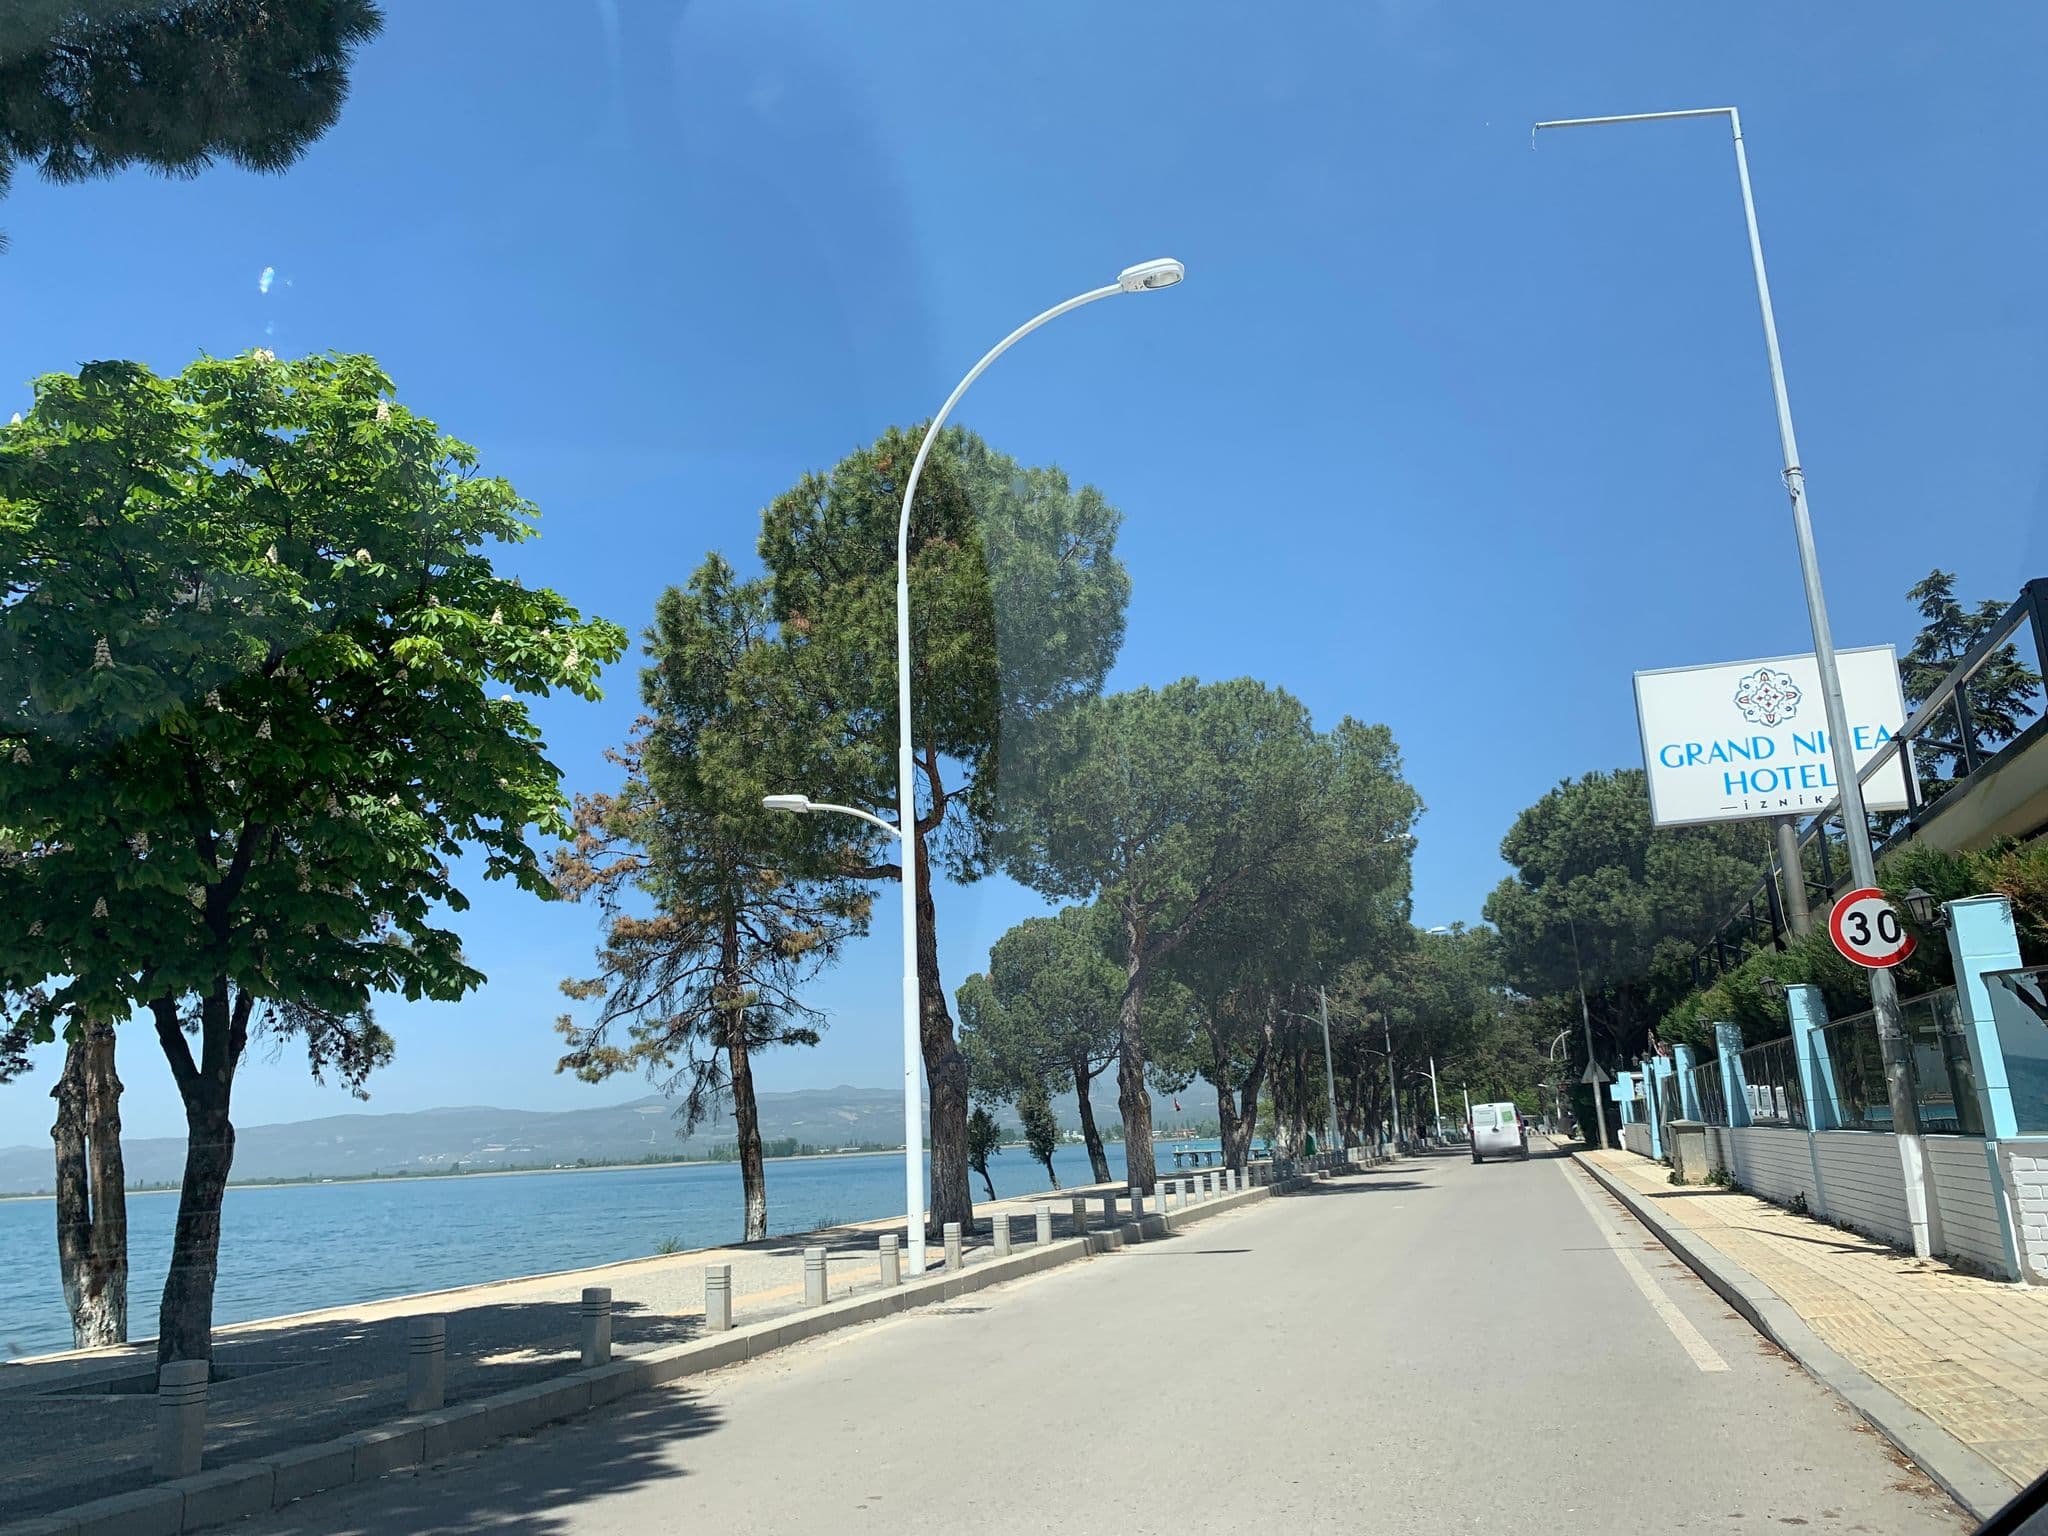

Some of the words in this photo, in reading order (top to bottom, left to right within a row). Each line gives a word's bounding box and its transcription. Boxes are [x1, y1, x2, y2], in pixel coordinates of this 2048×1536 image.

[1660, 736, 1775, 768] GRAND
[1792, 724, 1892, 756] NIEA
[1723, 764, 1838, 796] HOTEL
[1848, 909, 1901, 946] 30
